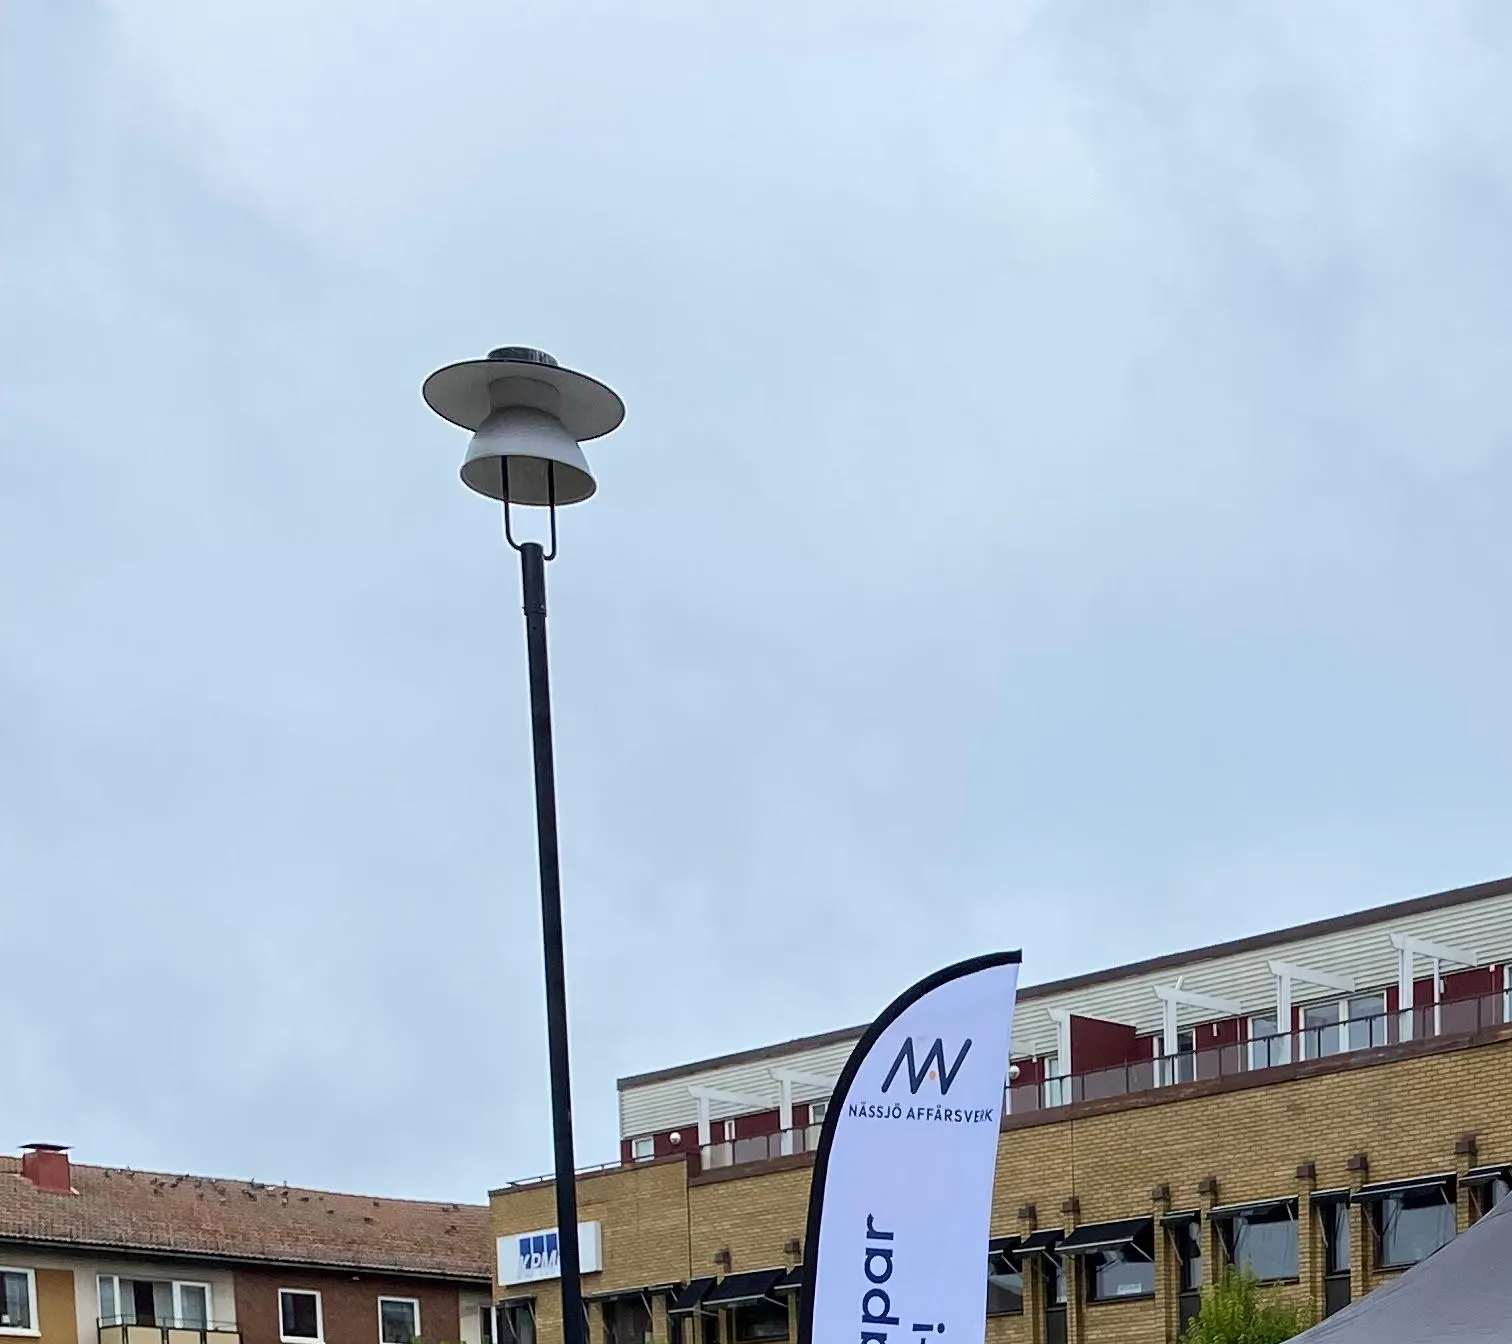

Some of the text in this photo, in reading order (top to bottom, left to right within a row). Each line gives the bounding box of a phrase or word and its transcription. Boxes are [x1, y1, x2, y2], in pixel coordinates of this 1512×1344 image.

[848, 1101, 994, 1122] NÄSSJÖ AFFÄRSVERK
[520, 1249, 560, 1271] KPM
